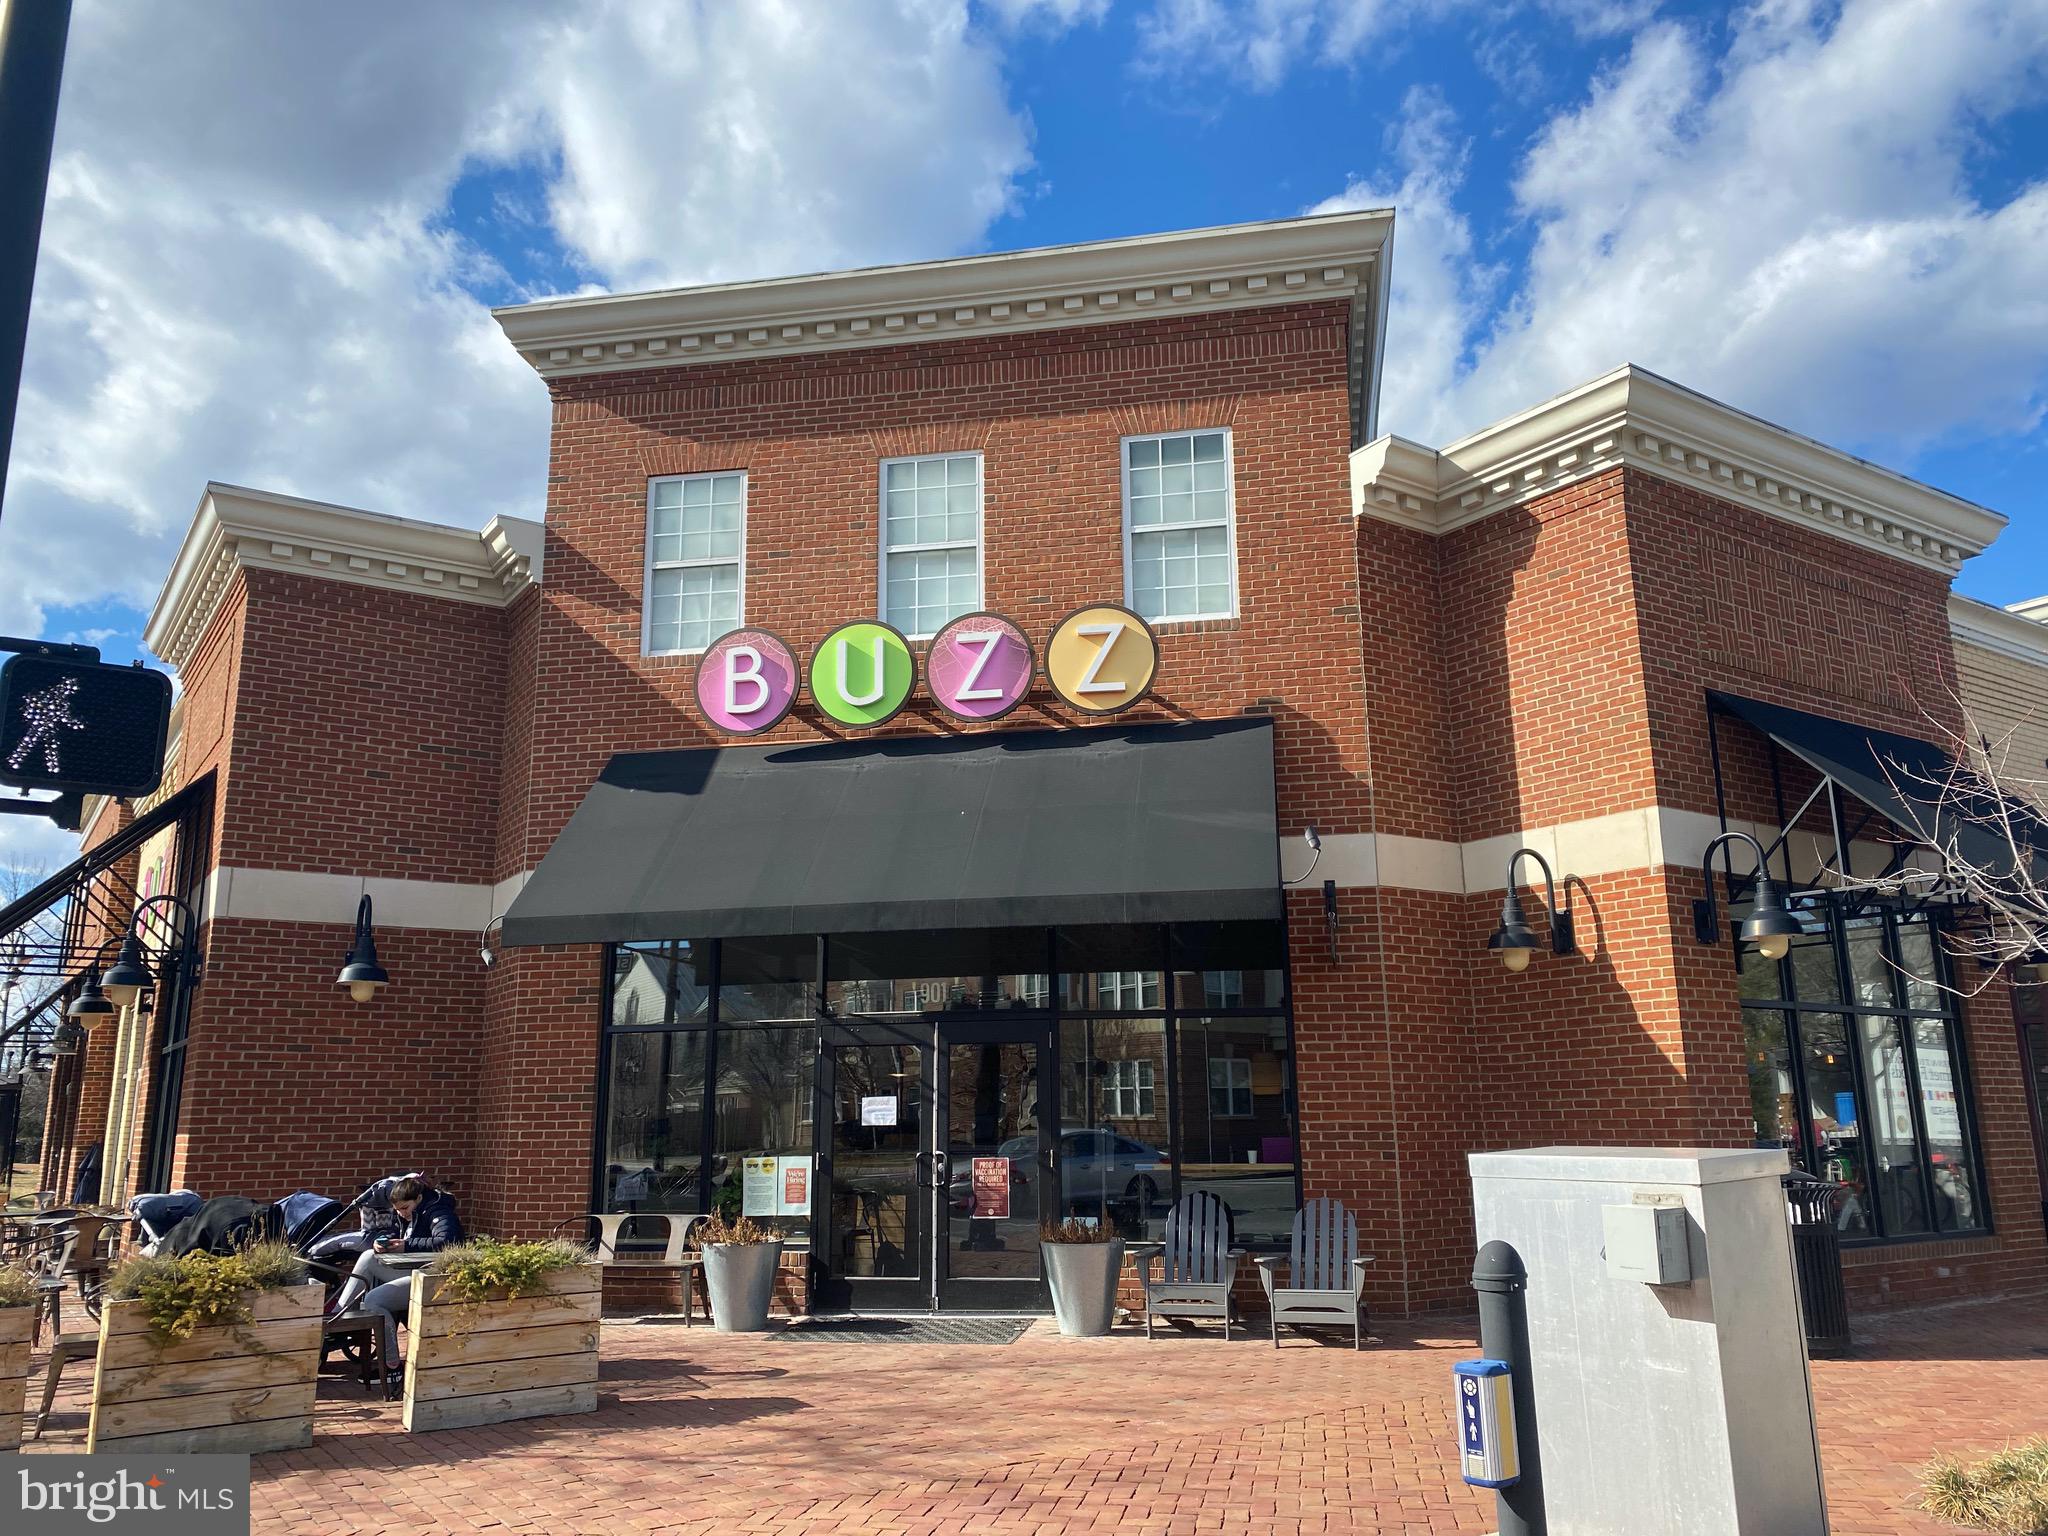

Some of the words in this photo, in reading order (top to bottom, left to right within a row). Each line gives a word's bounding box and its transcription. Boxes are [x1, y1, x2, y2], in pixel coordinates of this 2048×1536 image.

[724, 623, 1128, 714] BUZZ
[921, 982, 946, 1003] 901
[975, 1168, 1006, 1176] VACCINATION
